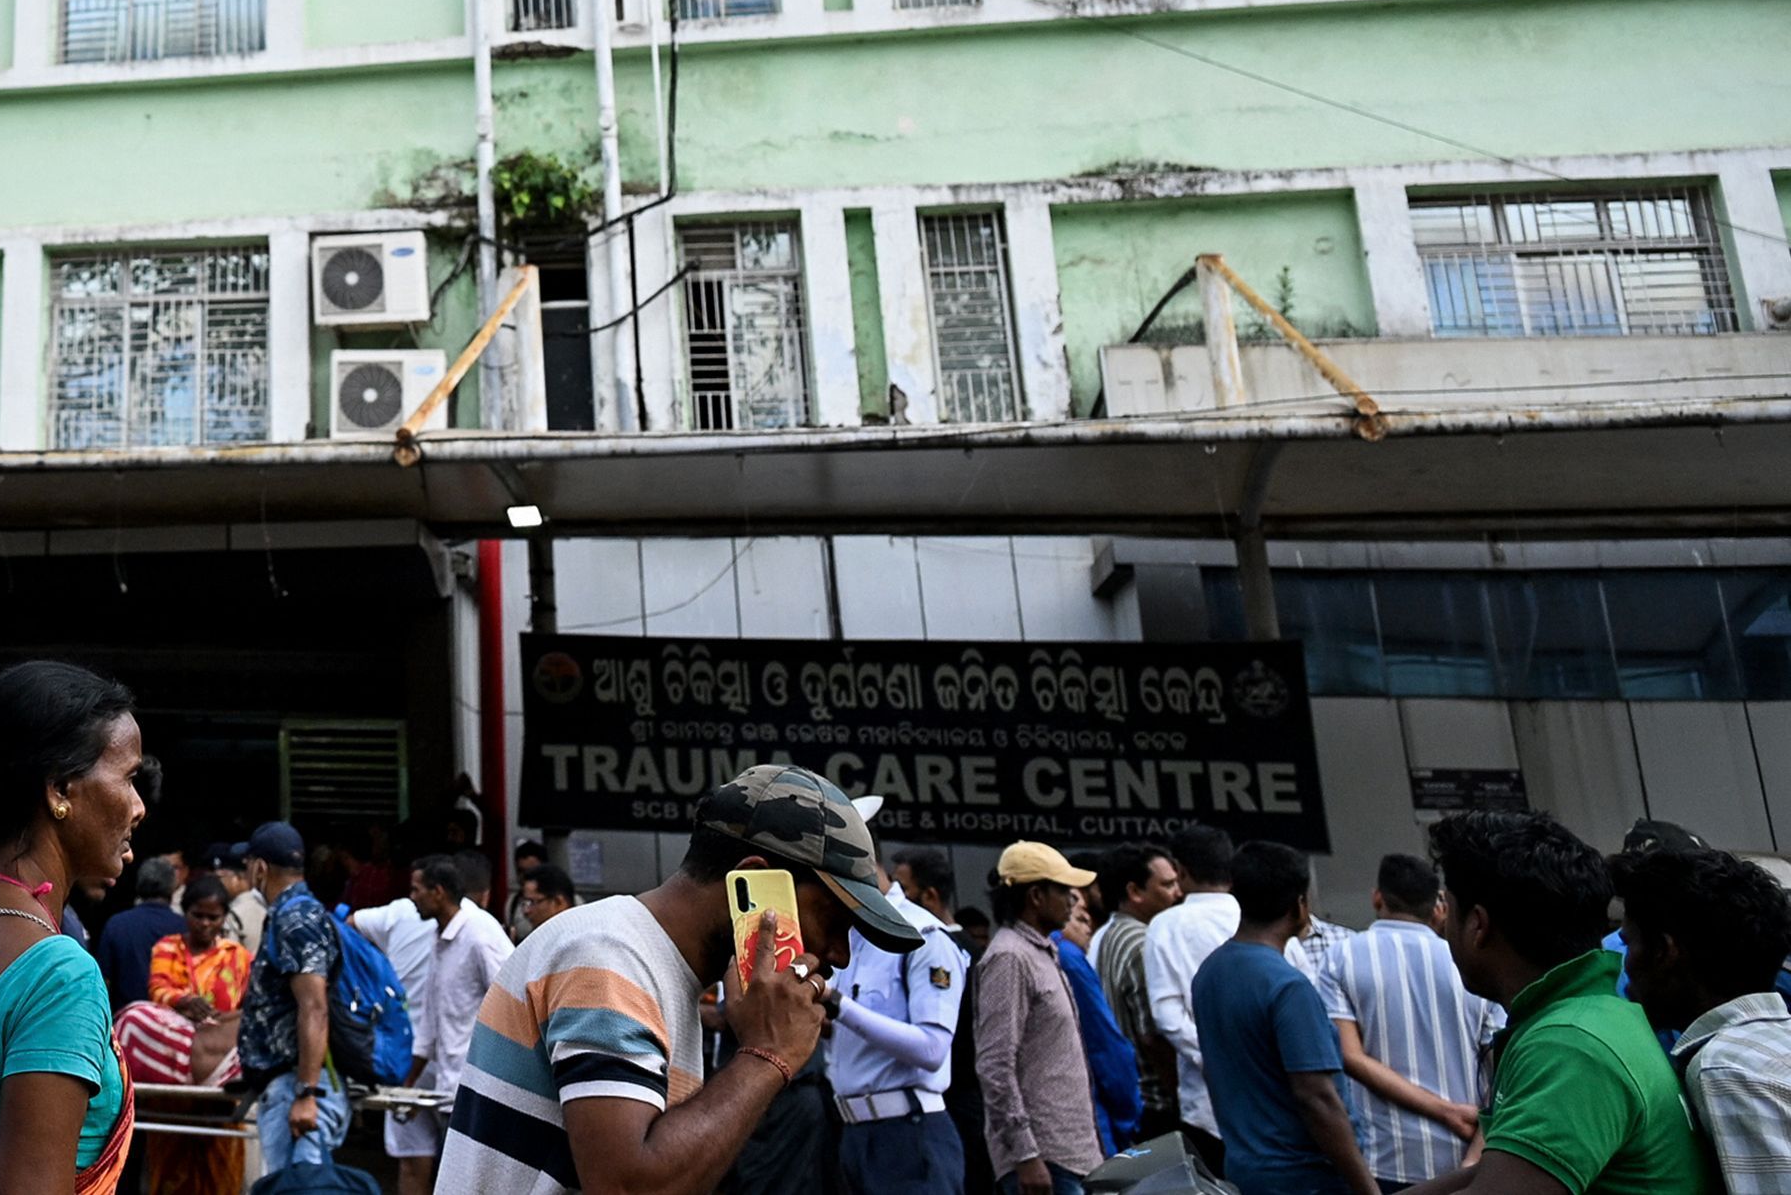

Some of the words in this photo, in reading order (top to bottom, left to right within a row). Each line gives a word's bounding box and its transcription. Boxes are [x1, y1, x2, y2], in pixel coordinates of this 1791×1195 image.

[592, 658, 656, 717] ଆଶୁ
[761, 659, 790, 707] ଓ
[933, 647, 1019, 711] ଜନିତ
[824, 751, 1001, 805] CARE
[1022, 756, 1303, 814] CENTRE
[631, 801, 679, 820] SCB
[919, 810, 937, 829] &
[944, 811, 1073, 836] HOSPITAL,
